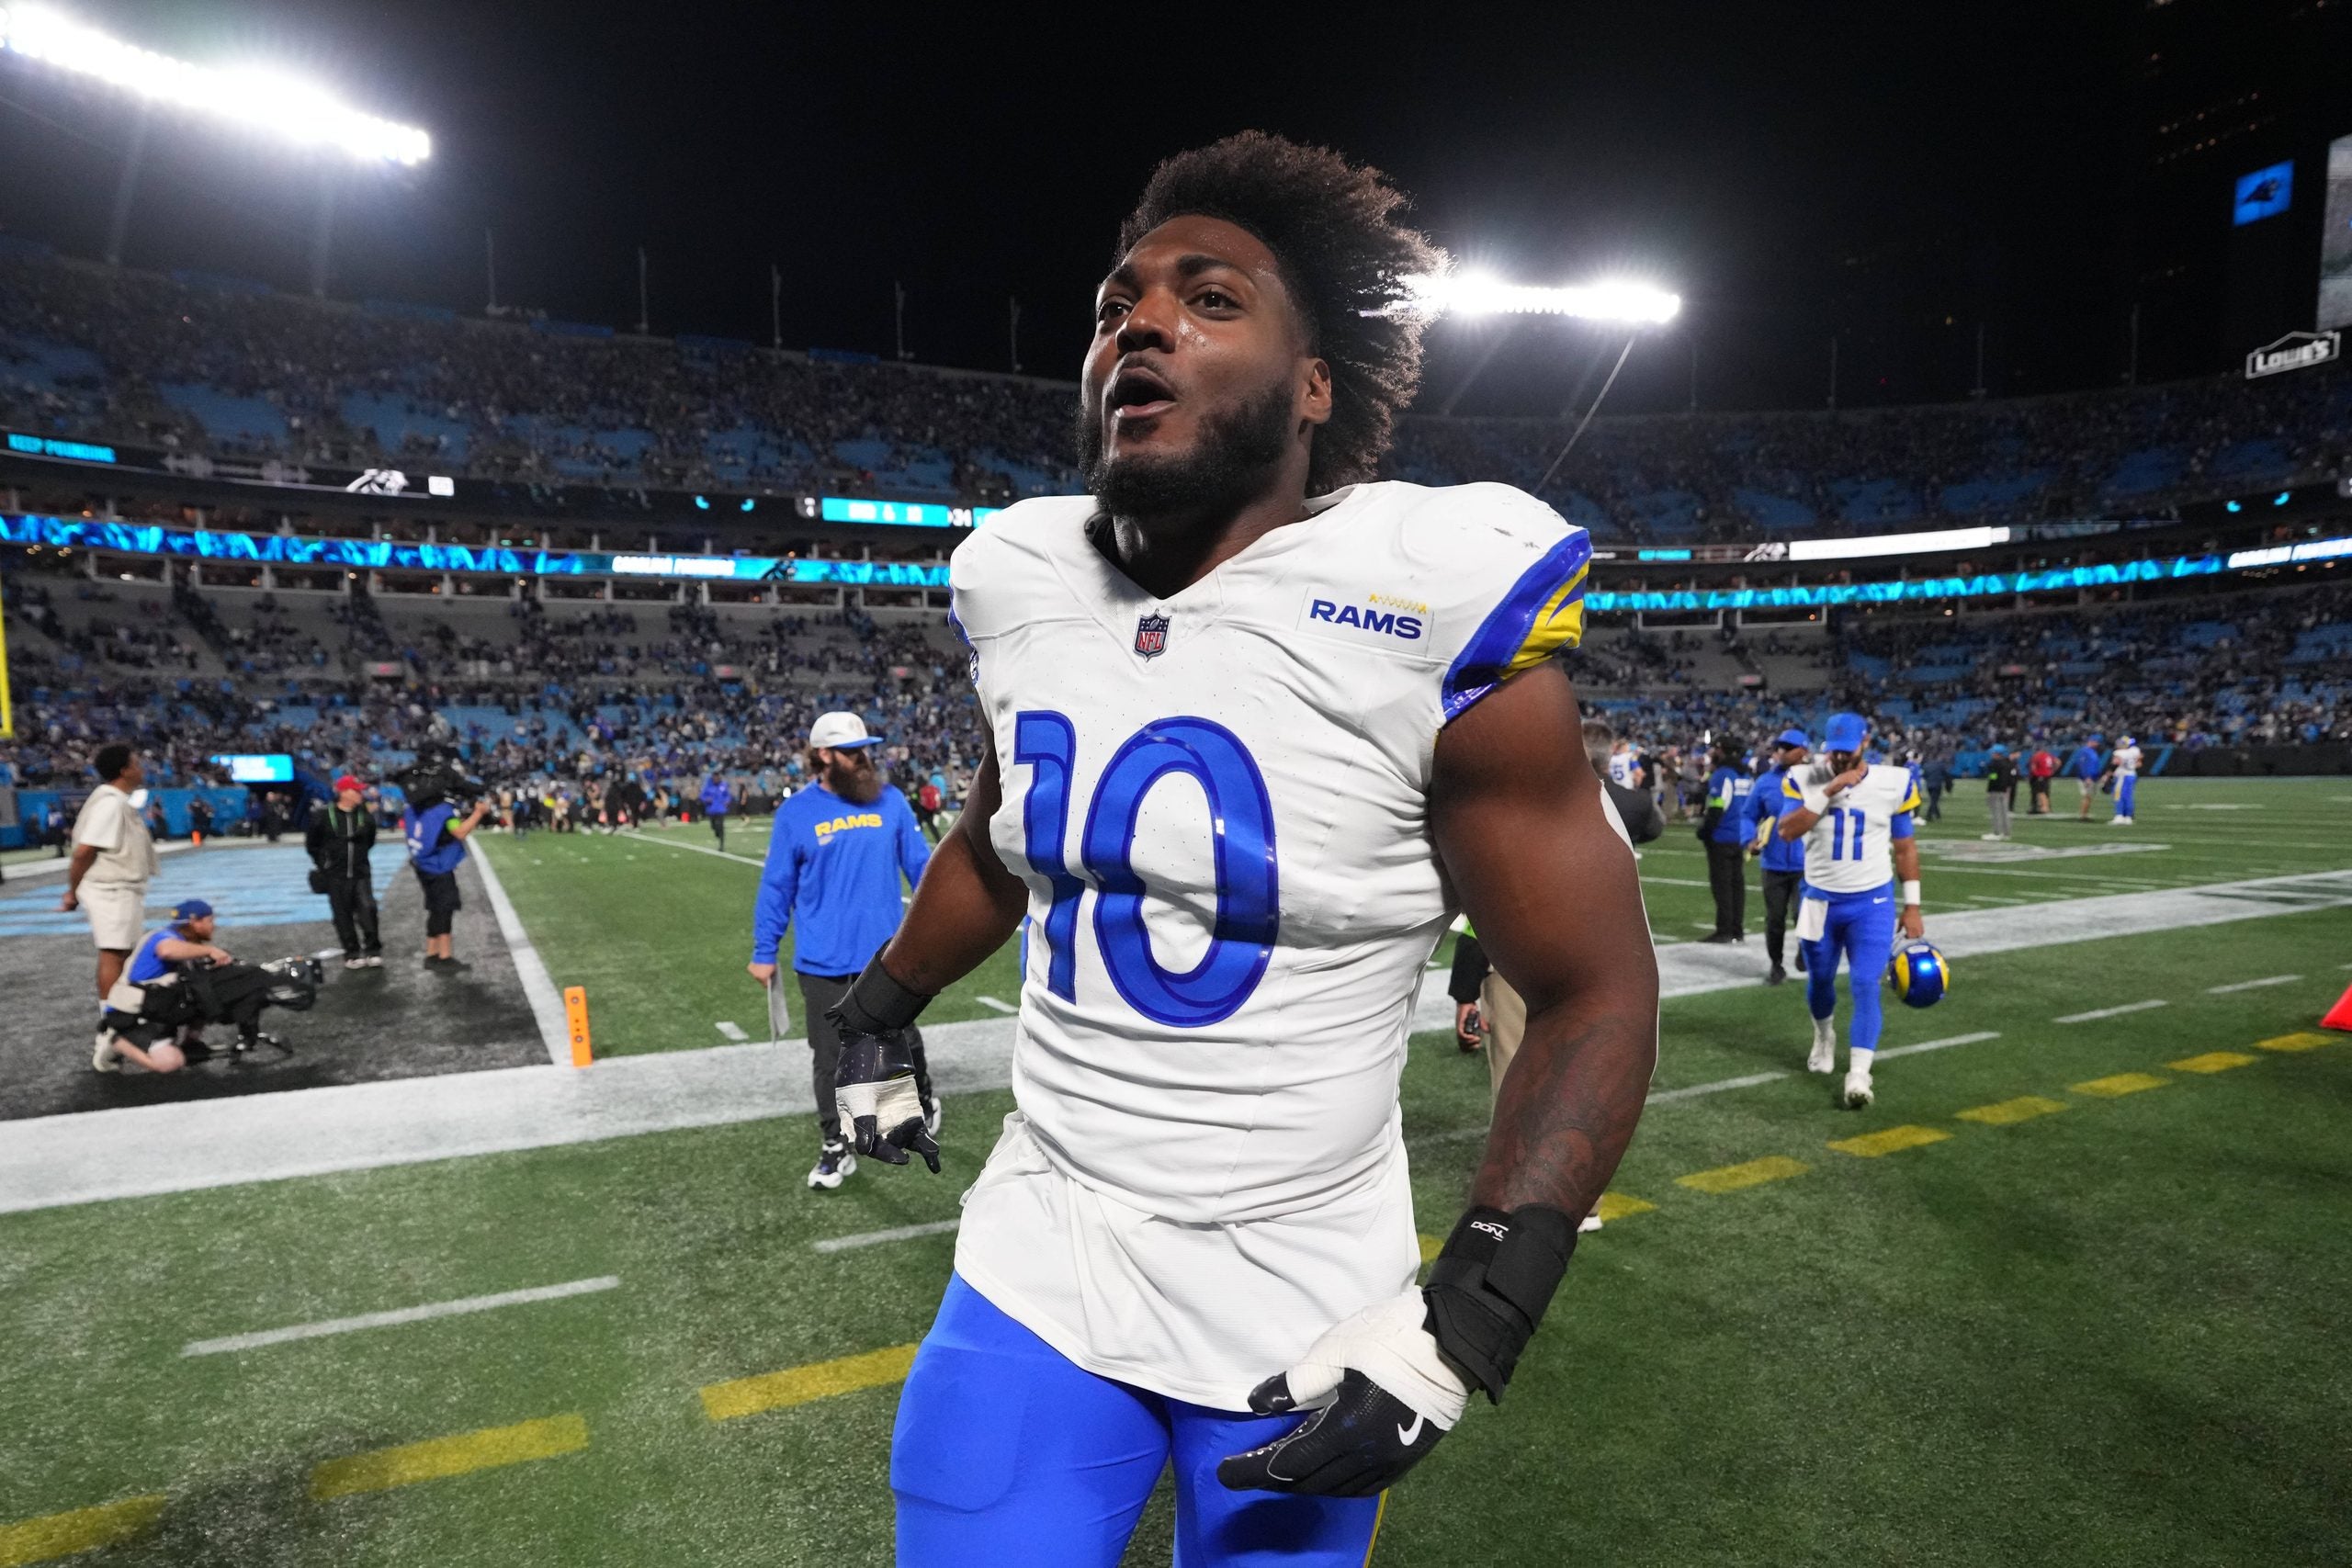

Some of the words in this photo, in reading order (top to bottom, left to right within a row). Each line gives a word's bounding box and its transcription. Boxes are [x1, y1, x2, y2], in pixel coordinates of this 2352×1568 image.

[1309, 599, 1423, 639] RAMS
[1137, 631, 1162, 651] NFL
[814, 813, 883, 837] RAMS
[1828, 807, 1865, 860] 11
[1013, 709, 1280, 1028] 10
